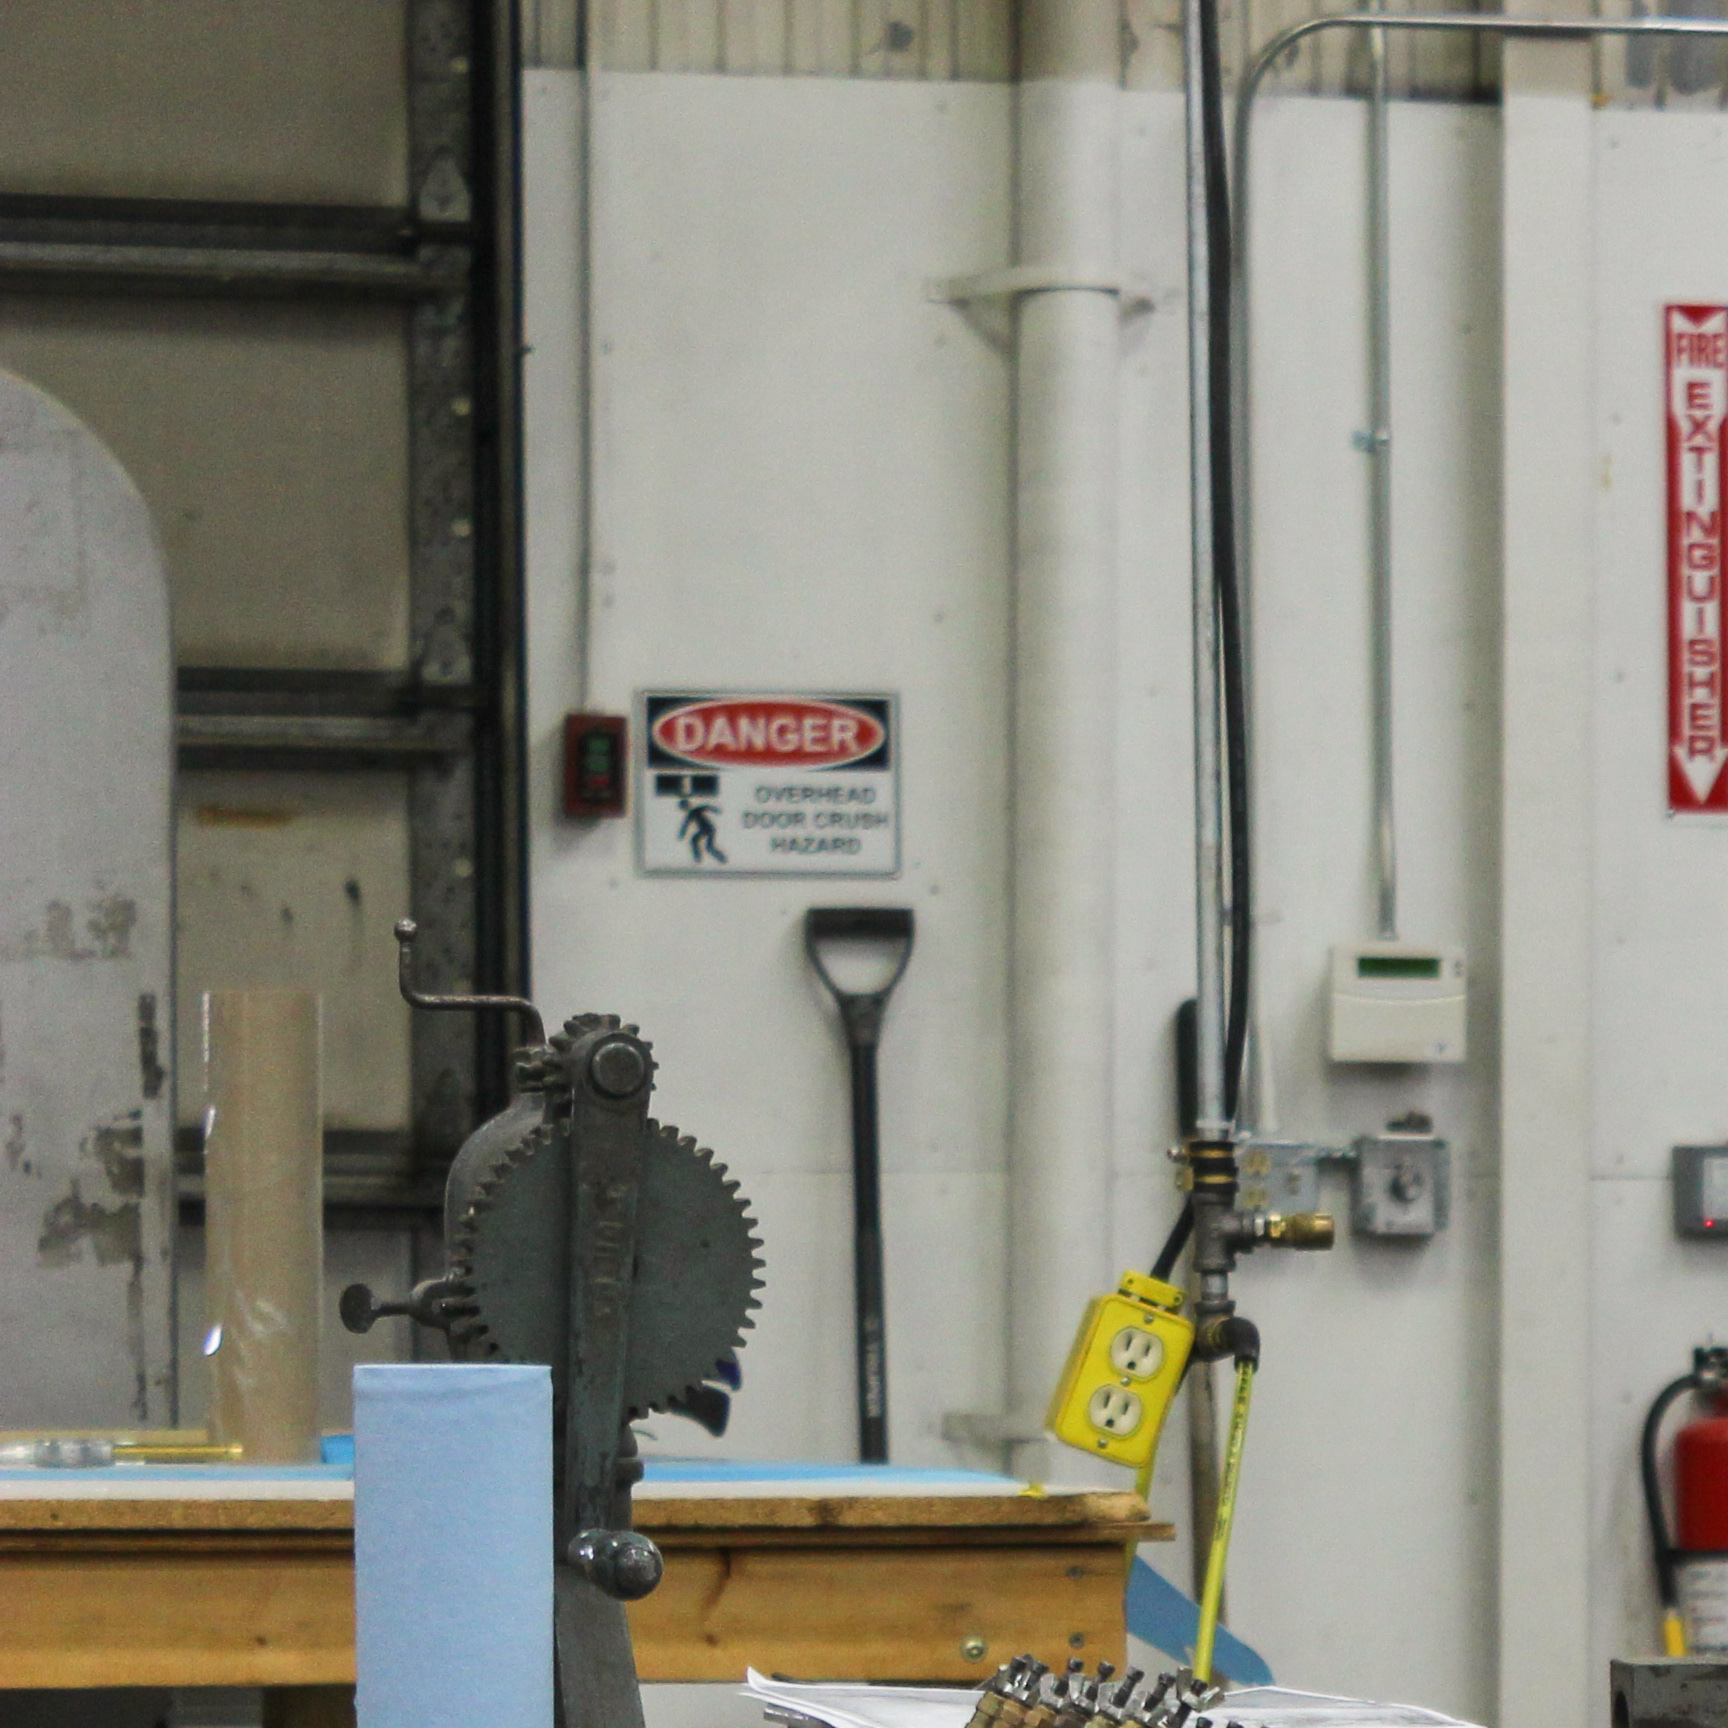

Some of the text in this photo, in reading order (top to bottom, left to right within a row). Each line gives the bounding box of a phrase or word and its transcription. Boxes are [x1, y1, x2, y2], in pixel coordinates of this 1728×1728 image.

[1675, 333, 1727, 368] FIRE
[1685, 381, 1718, 763] EXTINGUISHER
[675, 715, 862, 752] DANGER
[754, 784, 877, 805] OVERHEAD
[742, 811, 889, 830] DOOR CRUSH
[769, 836, 863, 855] HAZARD
